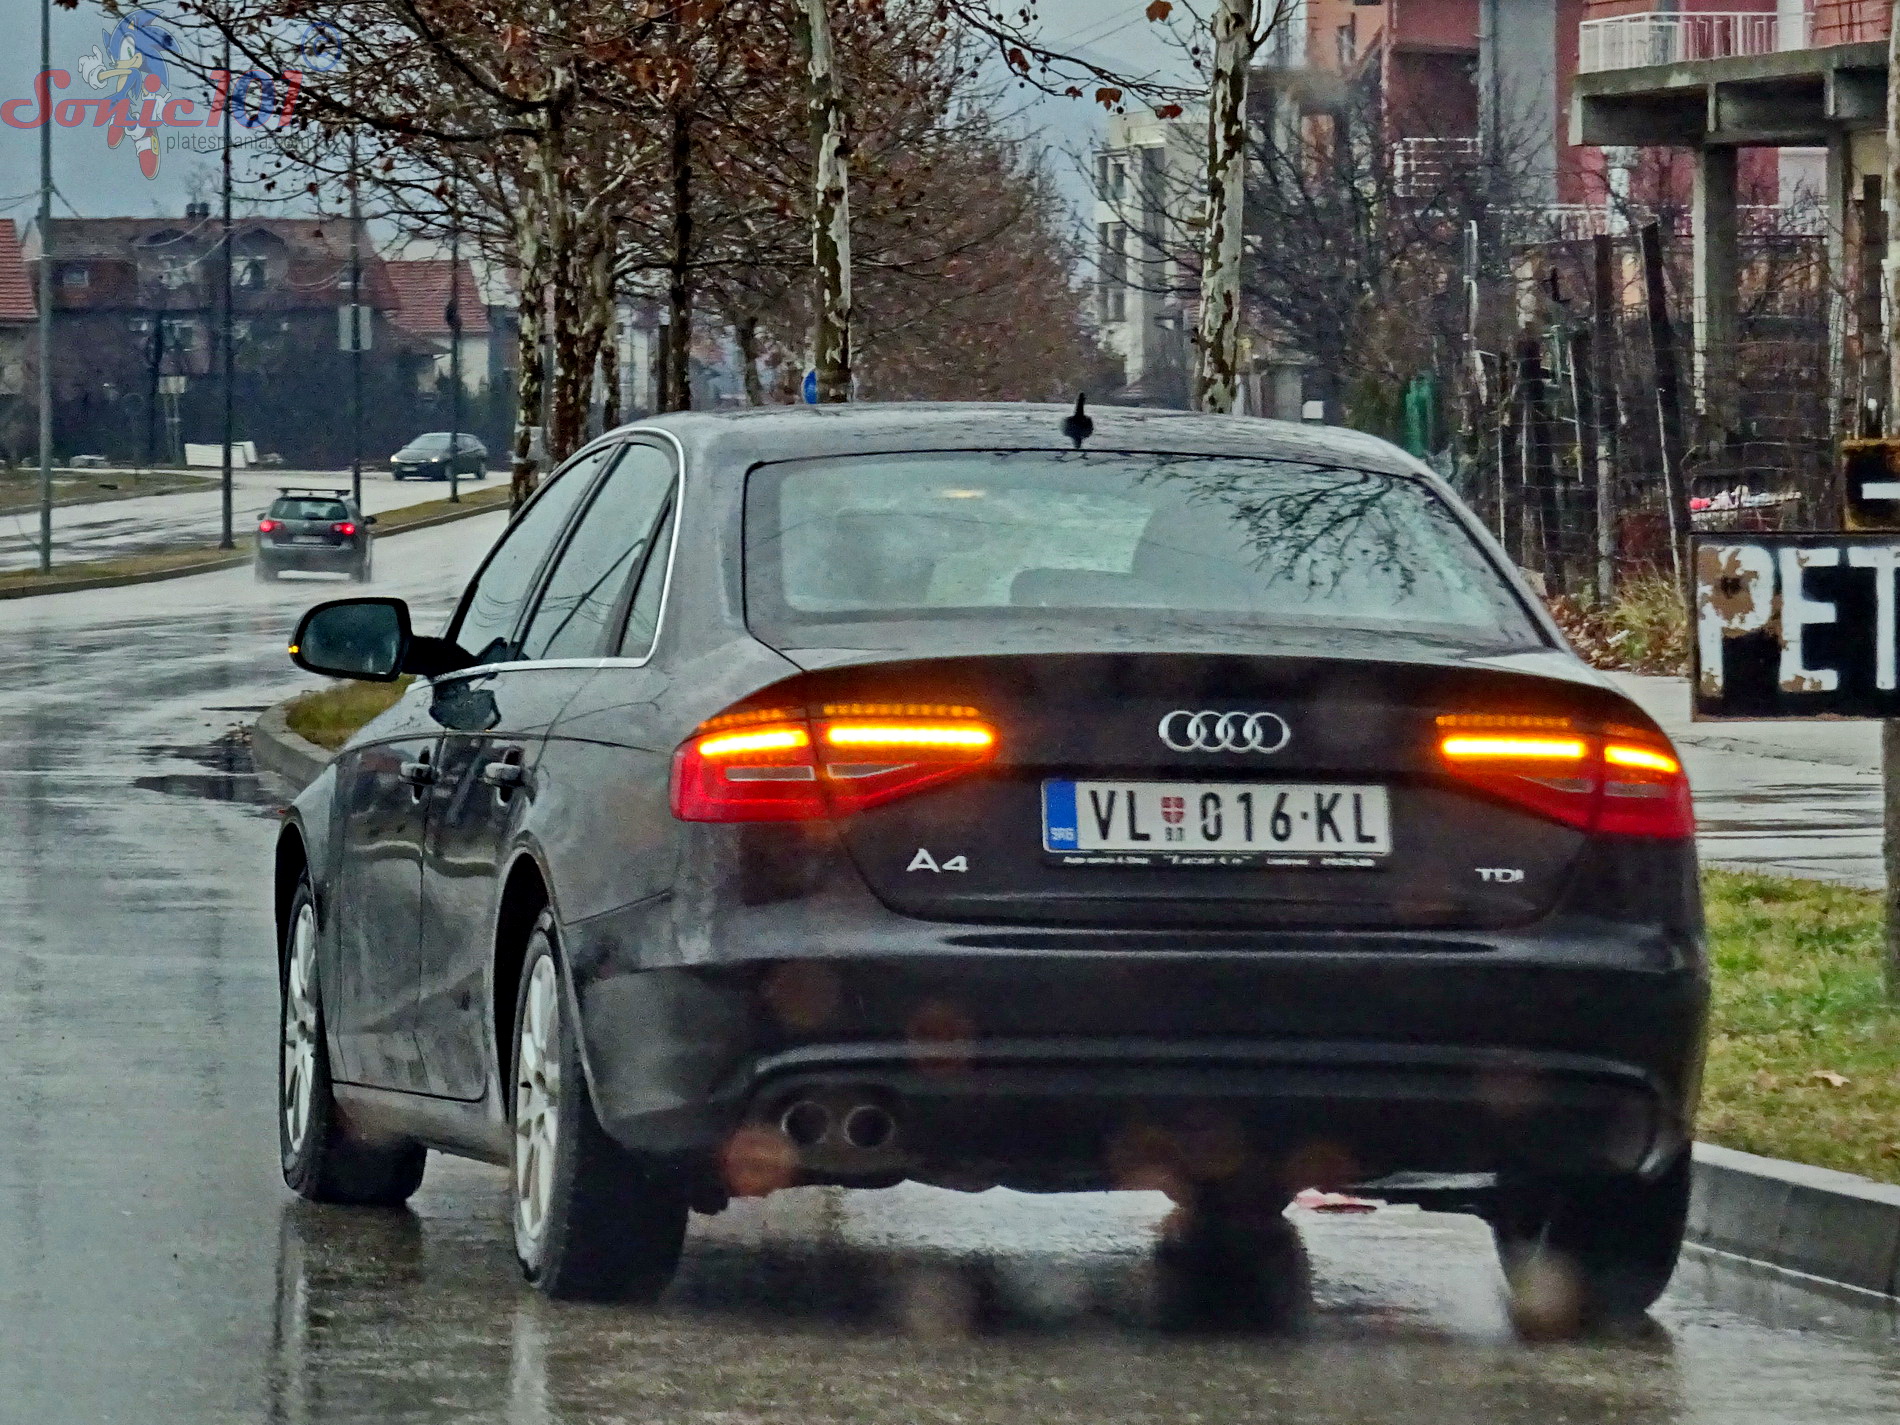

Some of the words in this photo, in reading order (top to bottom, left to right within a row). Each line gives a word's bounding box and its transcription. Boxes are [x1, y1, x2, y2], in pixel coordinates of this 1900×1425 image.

[1697, 545, 1900, 697] PET
[1089, 790, 1151, 841] VL
[906, 848, 968, 873] A4
[1475, 868, 1525, 883] TDI
